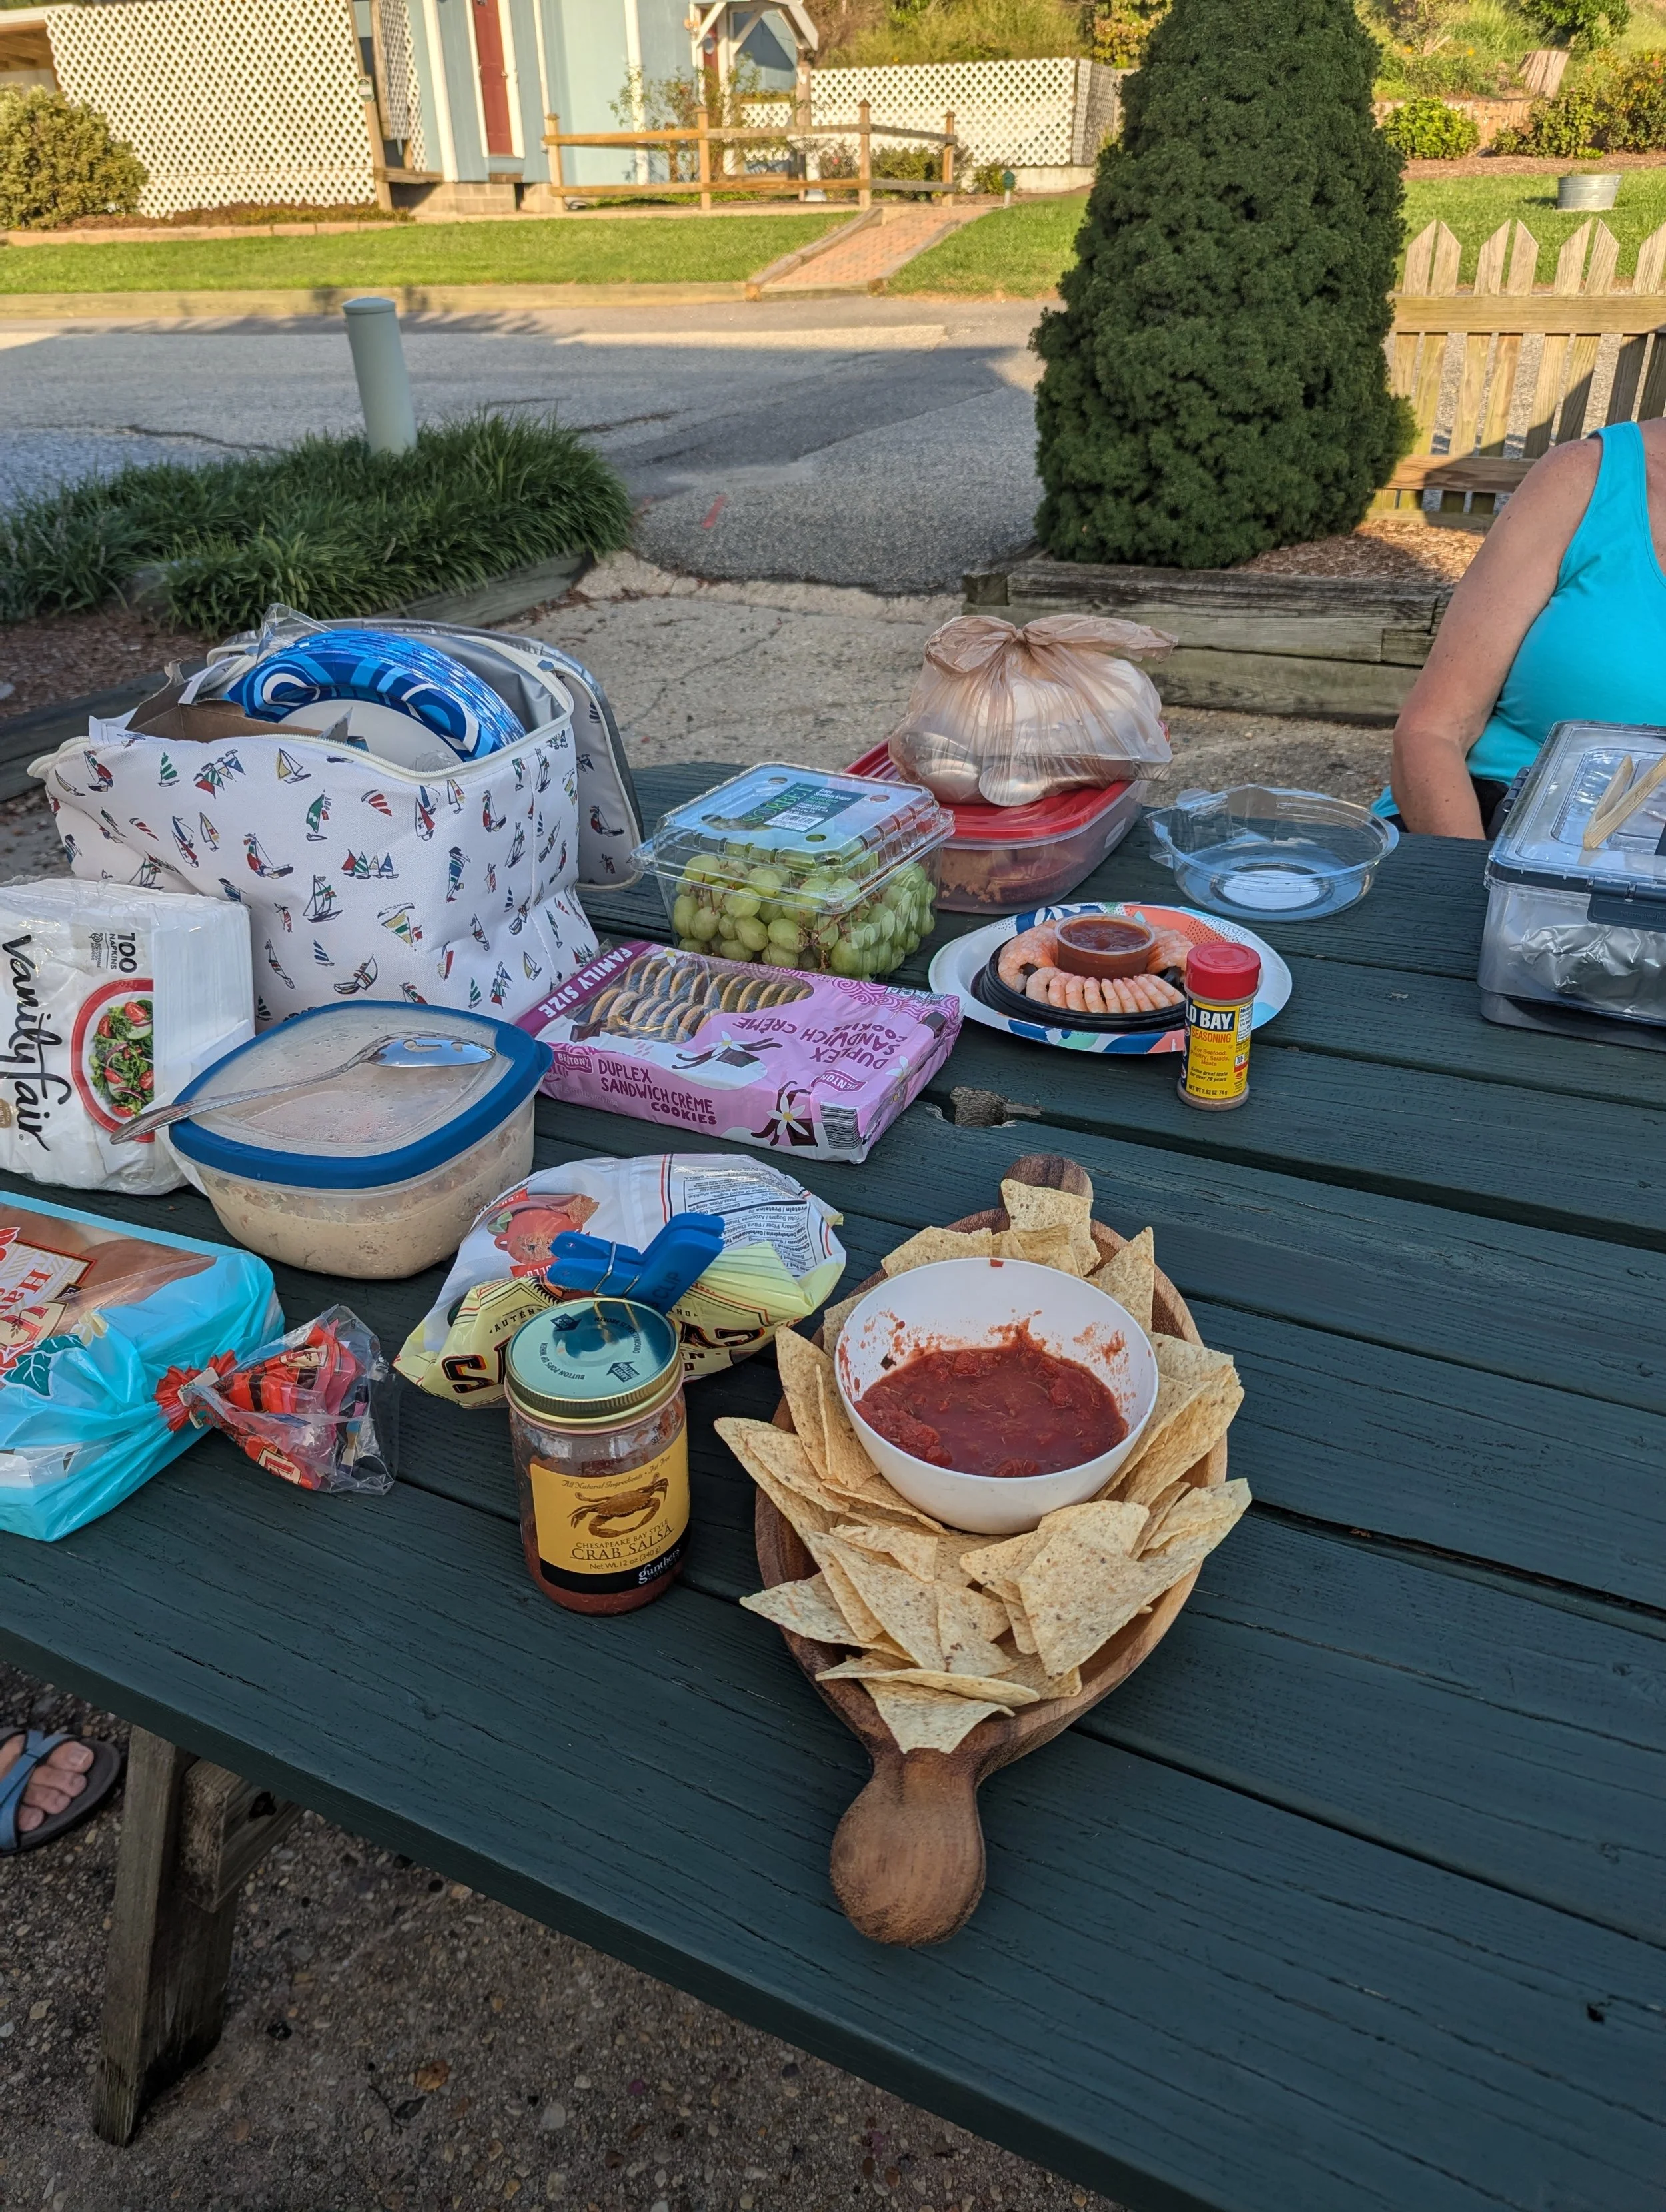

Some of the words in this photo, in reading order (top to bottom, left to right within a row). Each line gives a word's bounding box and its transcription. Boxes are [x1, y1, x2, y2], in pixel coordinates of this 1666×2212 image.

[117, 933, 137, 973] 100
[577, 947, 633, 991] FAMILY
[538, 985, 580, 1018] SIZE
[732, 1017, 798, 1034] CRÈME
[1186, 1001, 1197, 1023] LD
[1200, 1010, 1232, 1030] BAY
[800, 1028, 901, 1056] SANDWICH
[833, 1023, 908, 1043] COOKIES
[1192, 1027, 1232, 1043] SEASONING
[809, 1047, 890, 1070] DUPLEX
[598, 1059, 653, 1084] DUPLEX
[601, 1077, 668, 1104] SANDWICH
[670, 1091, 715, 1115] CRÈME
[650, 1101, 717, 1125] COOKIES
[788, 1235, 808, 1244] Sodium
[653, 1272, 682, 1300] CLIP
[539, 1342, 548, 1357] WHEN
[545, 1361, 560, 1373] POPS
[558, 1370, 585, 1380] BUTTON
[575, 1481, 604, 1490] Natural
[605, 1473, 643, 1488] Ingredients
[572, 1547, 621, 1560] CRAB
[628, 1524, 675, 1556] SALSA
[576, 1538, 630, 1549] CHESAPEAKE
[633, 1532, 647, 1542] BAY
[649, 1518, 668, 1535] STYLE
[639, 1549, 654, 1562] (340
[655, 1546, 661, 1555] g)
